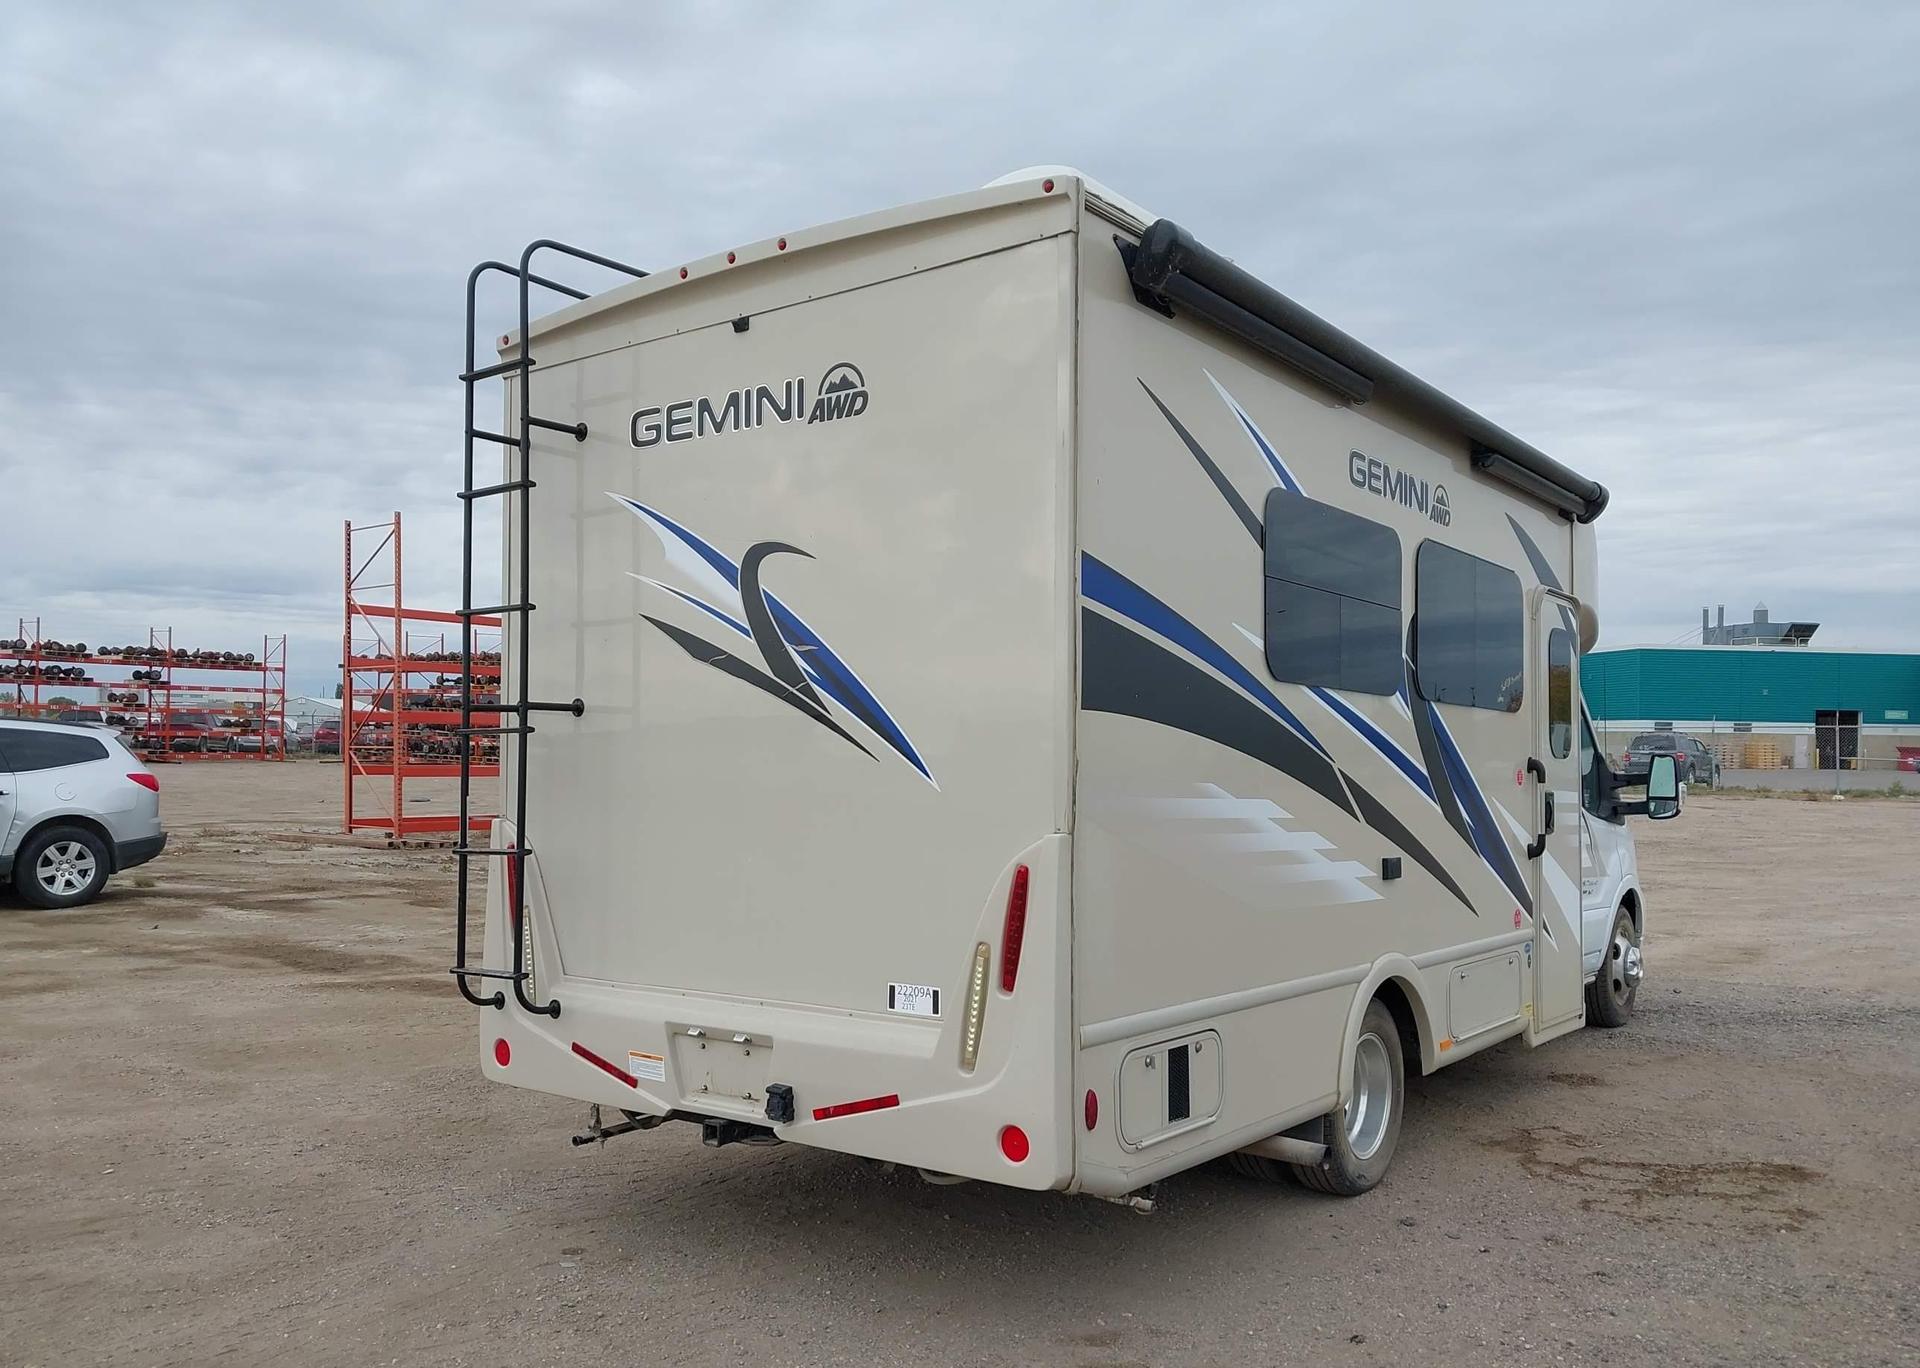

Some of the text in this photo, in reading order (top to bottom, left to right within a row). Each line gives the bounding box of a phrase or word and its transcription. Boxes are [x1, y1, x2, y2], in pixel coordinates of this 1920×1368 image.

[629, 375, 869, 449] GEMINI AWD
[1348, 448, 1452, 528] GEMINI AWD
[897, 985, 932, 998] 22209A
